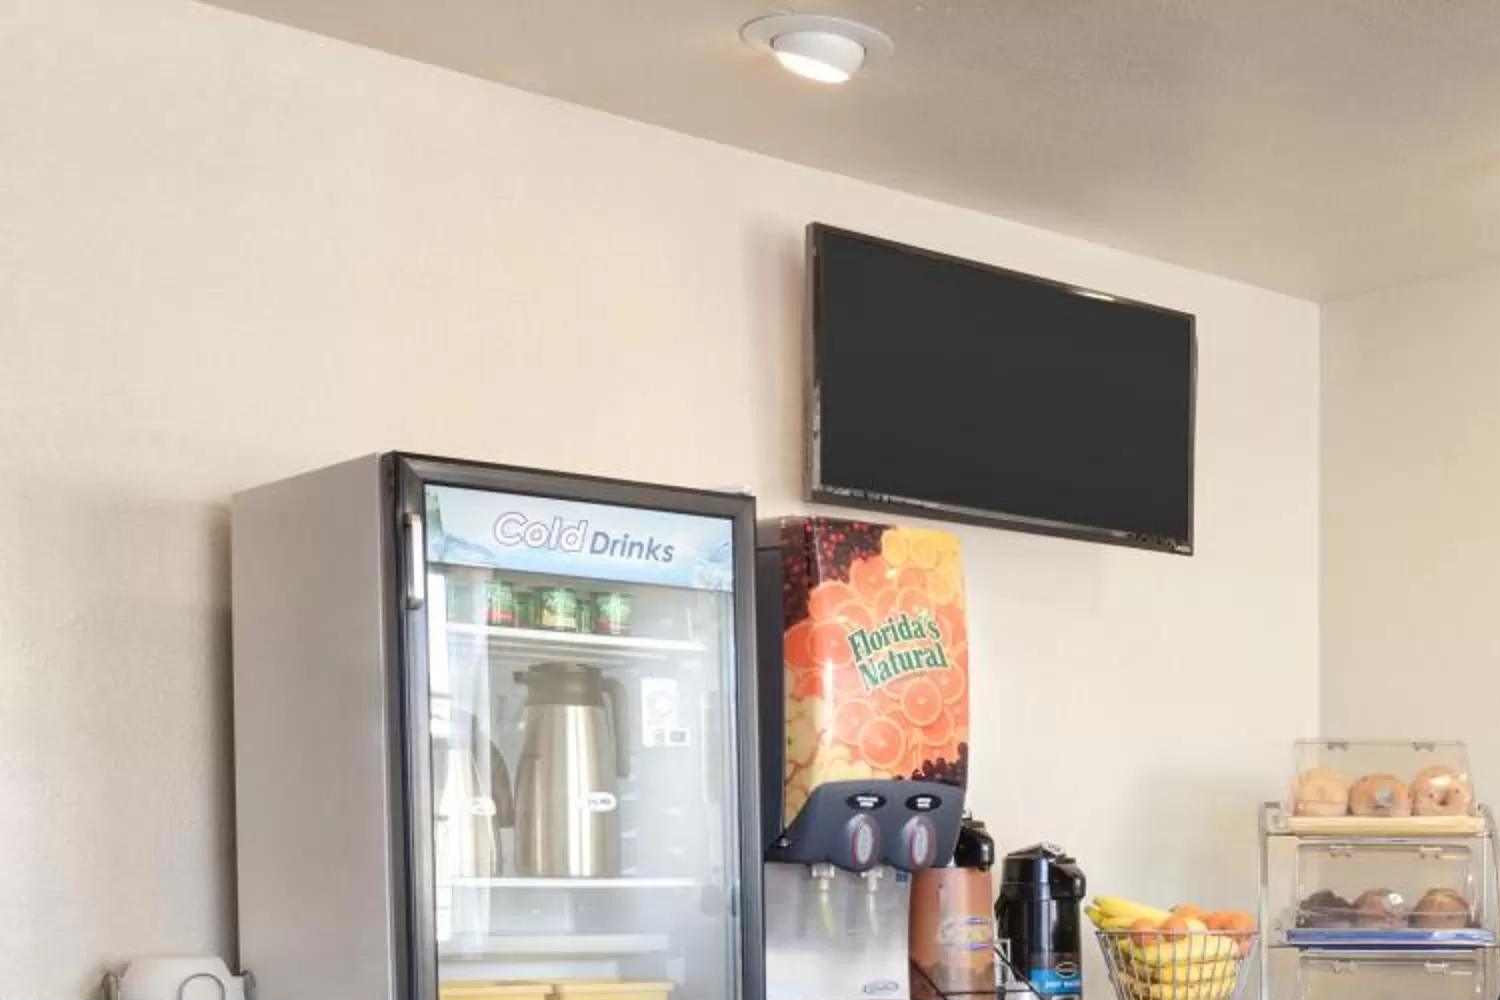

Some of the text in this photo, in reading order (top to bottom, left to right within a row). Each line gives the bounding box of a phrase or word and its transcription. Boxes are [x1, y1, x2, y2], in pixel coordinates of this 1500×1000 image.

[493, 511, 676, 563] Cold Drinks
[848, 613, 942, 663] Florida's
[859, 642, 949, 692] Natural
